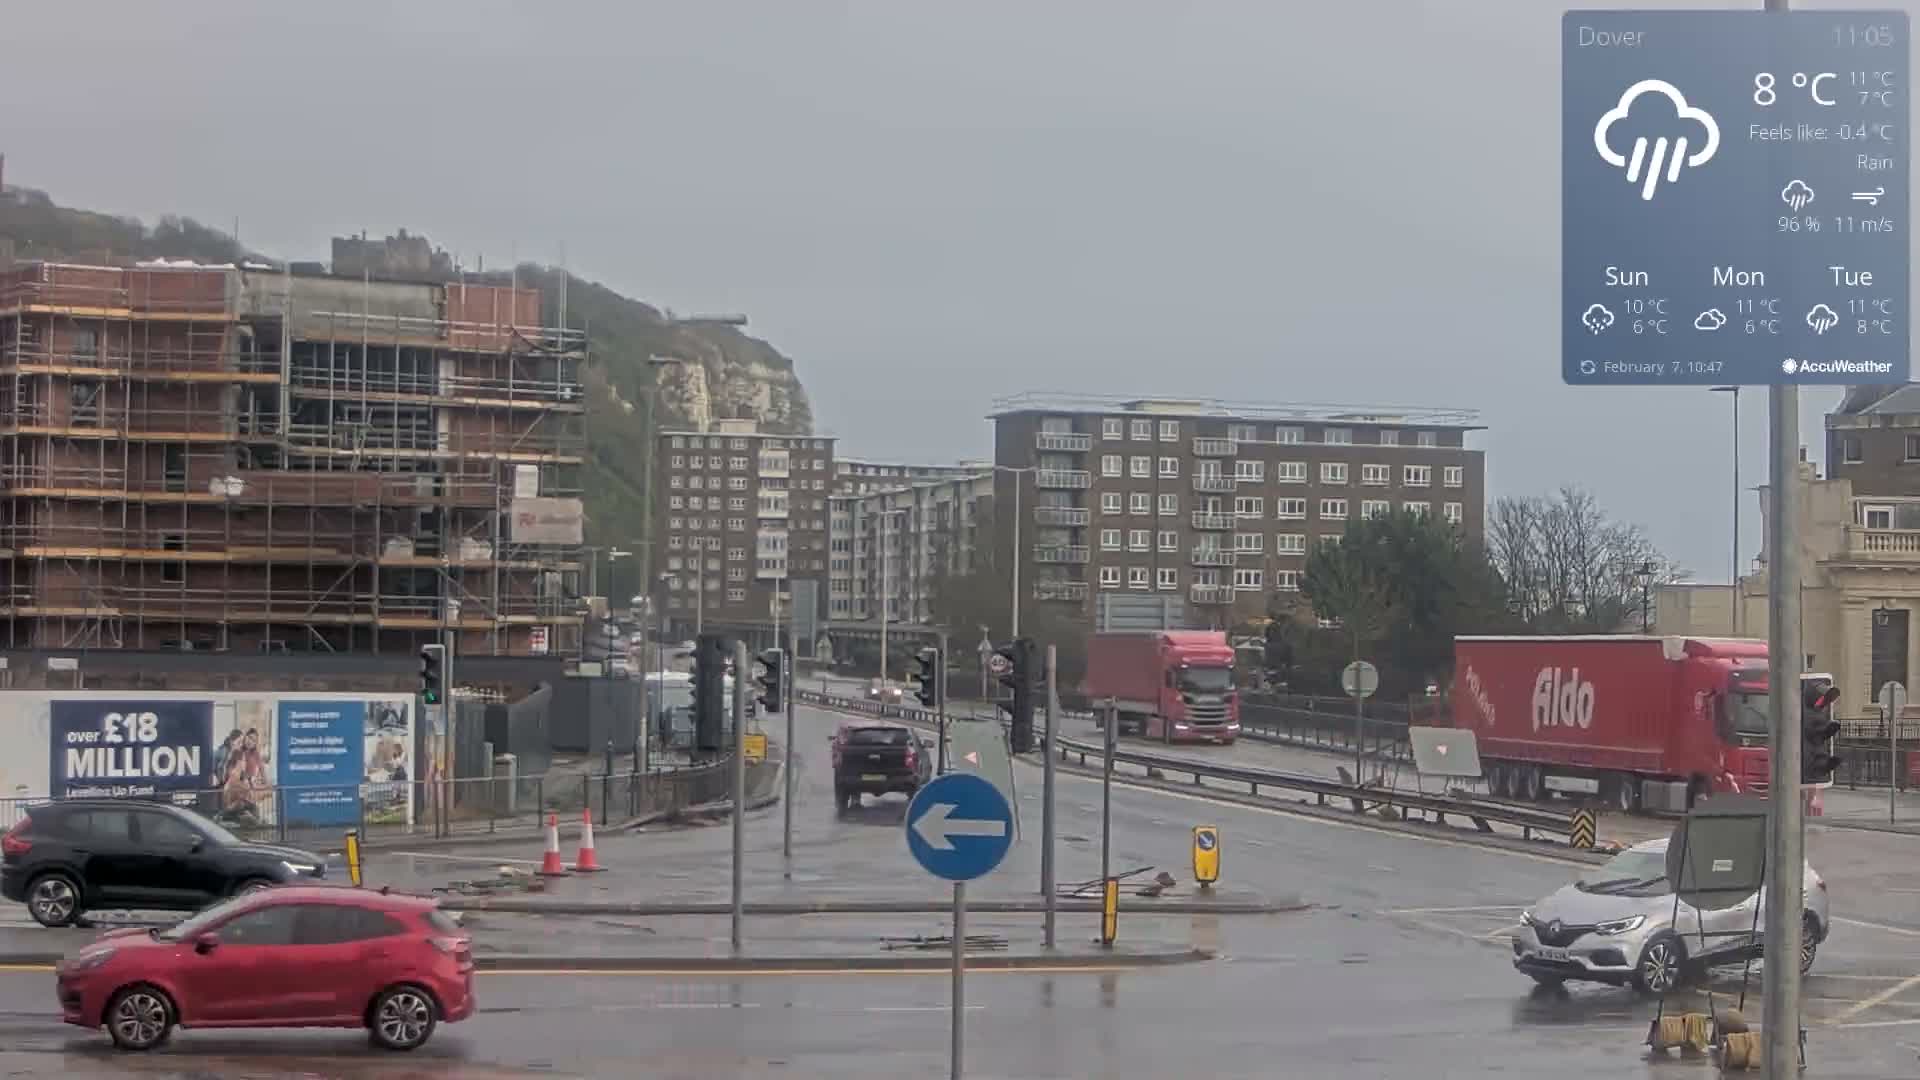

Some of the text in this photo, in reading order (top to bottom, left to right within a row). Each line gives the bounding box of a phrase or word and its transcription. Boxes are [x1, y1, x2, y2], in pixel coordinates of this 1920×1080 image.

[1532, 666, 1595, 733] Aldo
[67, 712, 158, 743] over £18
[66, 746, 200, 778] MILLION
